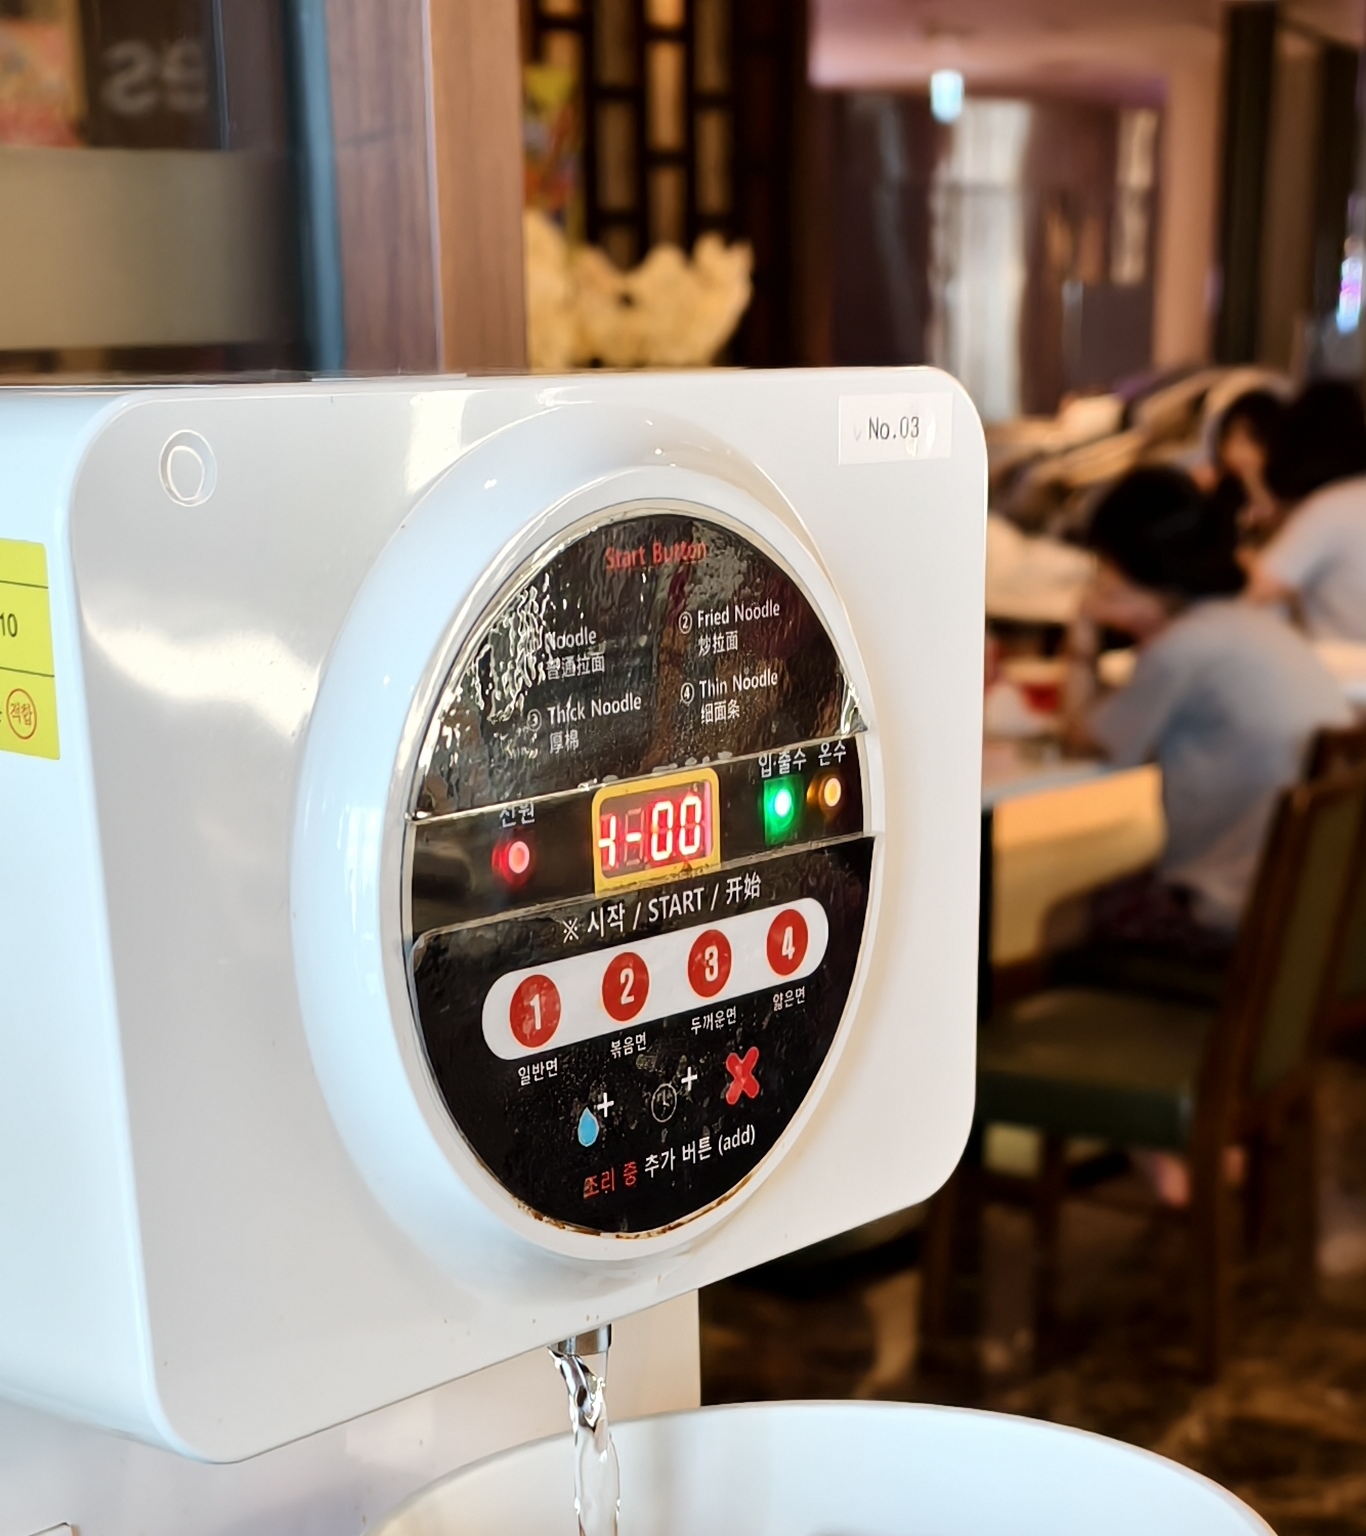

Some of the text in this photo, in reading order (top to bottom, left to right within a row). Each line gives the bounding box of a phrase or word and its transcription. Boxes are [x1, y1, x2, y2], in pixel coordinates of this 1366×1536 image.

[868, 416, 920, 440] No.03
[605, 540, 708, 571] Start Button
[697, 604, 730, 628] Fried
[734, 599, 781, 622] Noodle
[698, 630, 739, 657] 炒拉面
[699, 677, 728, 699] Thin
[732, 668, 778, 693] Noodle
[546, 700, 586, 725] Thick
[591, 690, 642, 718] Noodle
[700, 699, 740, 725] 细面条
[818, 740, 847, 767] 온수
[588, 902, 626, 938] 시작
[648, 886, 705, 923] START
[725, 871, 762, 906] 开始
[528, 926, 795, 1031] 1 2 3 4
[517, 1057, 558, 1087] 일반면
[583, 1123, 756, 1199] 조리 중 추가 버튼 (add)
